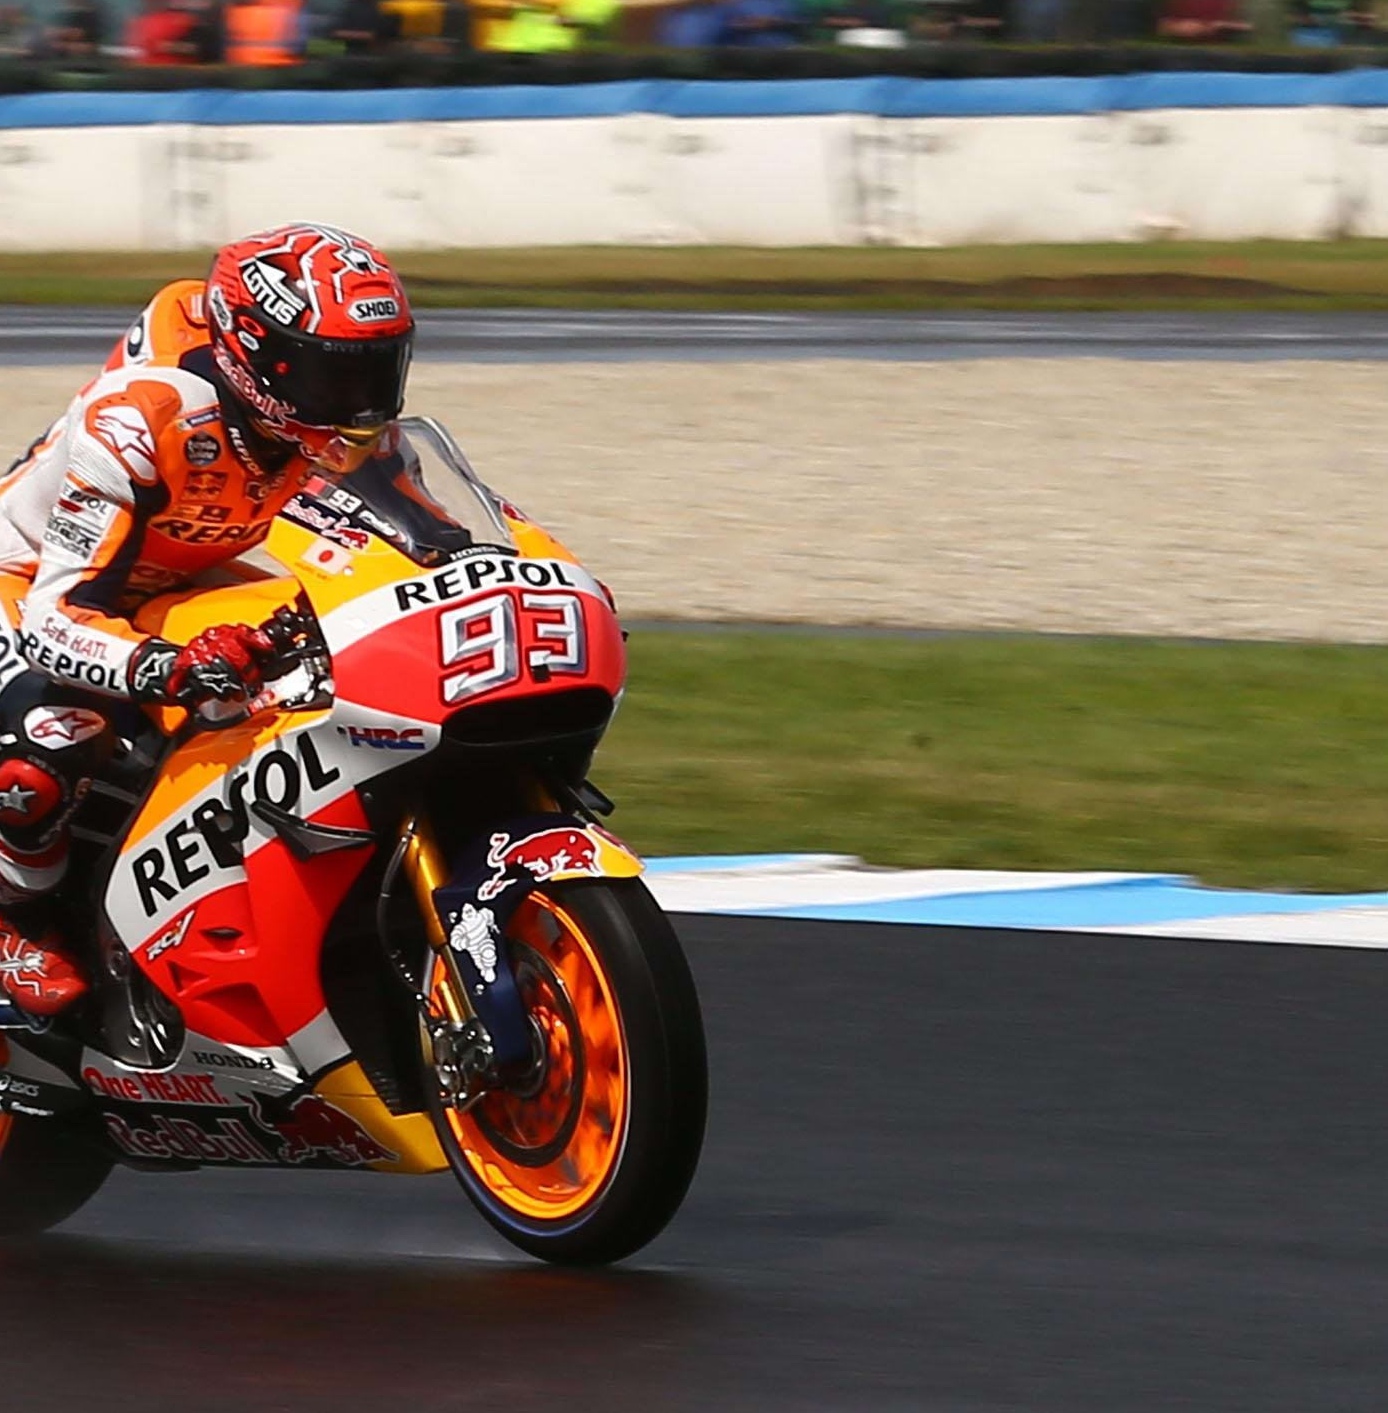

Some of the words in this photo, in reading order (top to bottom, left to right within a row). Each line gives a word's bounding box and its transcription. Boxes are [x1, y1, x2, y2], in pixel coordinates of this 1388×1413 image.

[242, 264, 298, 326] LOTUS
[355, 299, 396, 319] SHOEI
[228, 427, 264, 476] REPSOL
[328, 489, 363, 514] 93
[394, 557, 576, 611] REPSOL
[22, 633, 121, 690] REPSOL
[439, 590, 587, 705] 93
[345, 726, 426, 750] HRC
[132, 731, 340, 917] REPSOL
[84, 1066, 143, 1100] One
[193, 1051, 274, 1072] HONDA
